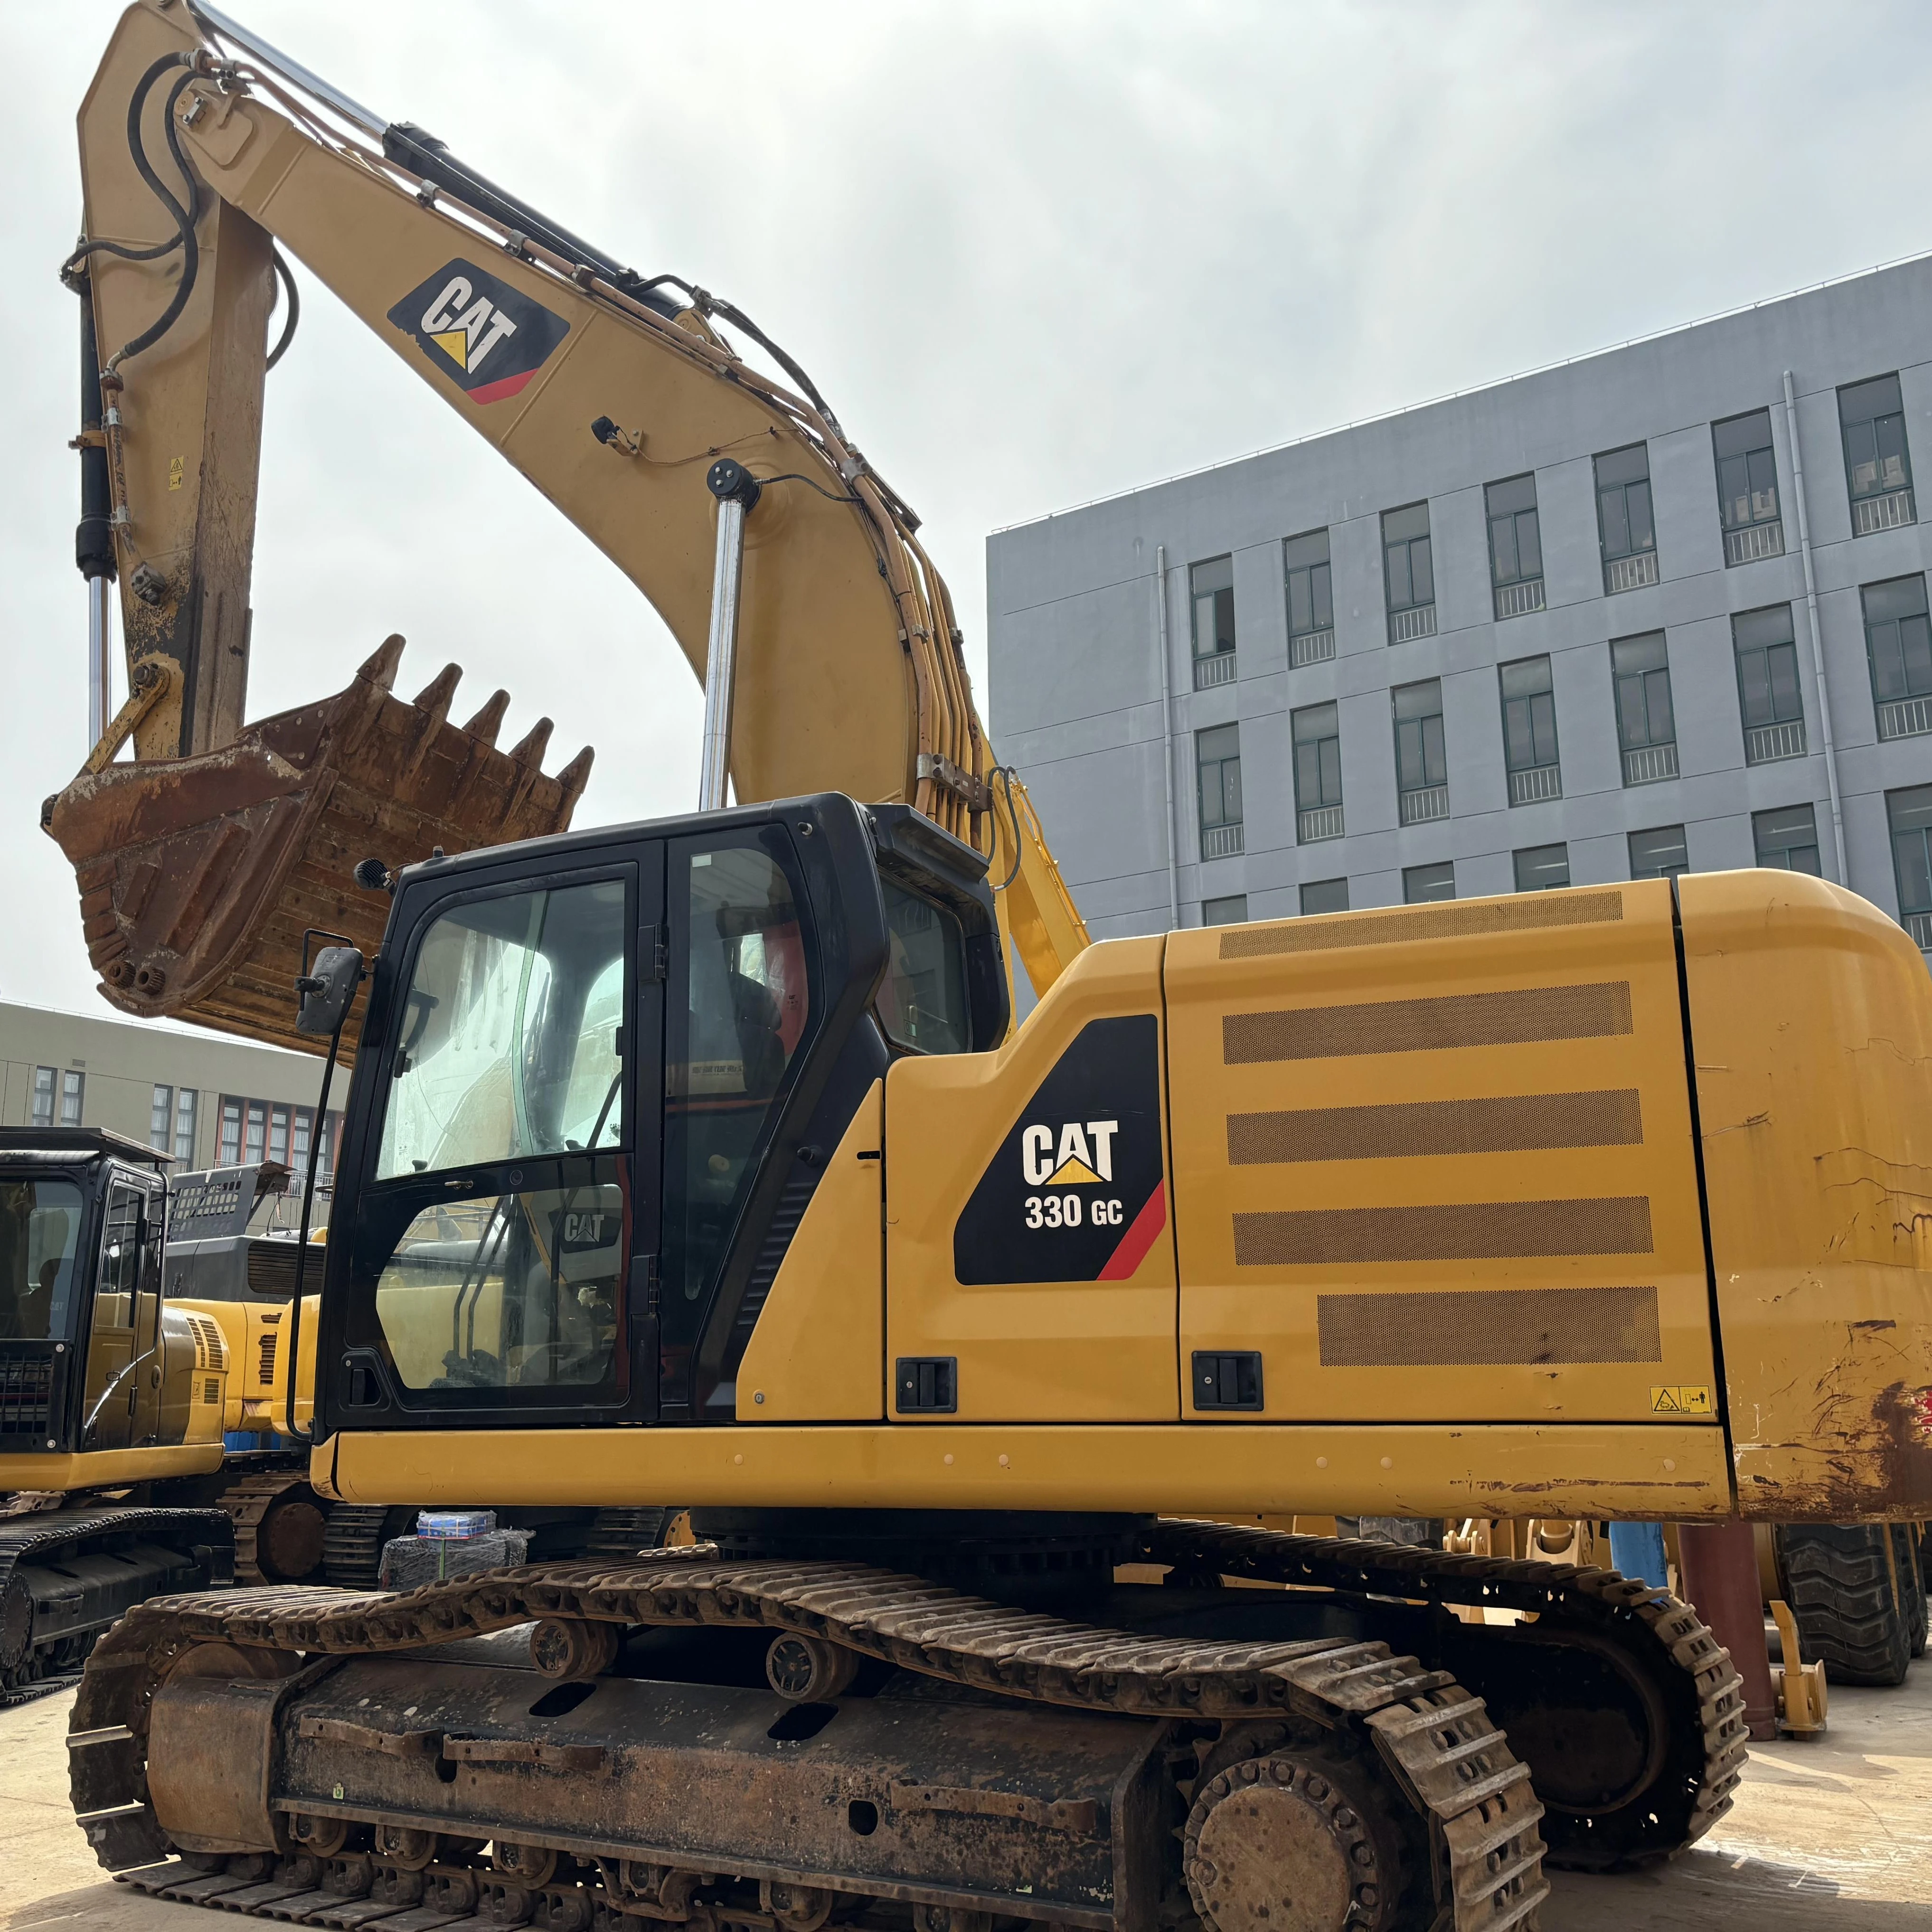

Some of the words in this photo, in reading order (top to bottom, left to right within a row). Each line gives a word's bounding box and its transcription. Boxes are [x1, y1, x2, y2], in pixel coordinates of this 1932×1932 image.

[421, 276, 517, 375] CAT
[1022, 1120, 1118, 1186] CAT
[564, 1213, 604, 1242] CAT
[1025, 1195, 1082, 1229] 330
[1092, 1199, 1123, 1225] GC
